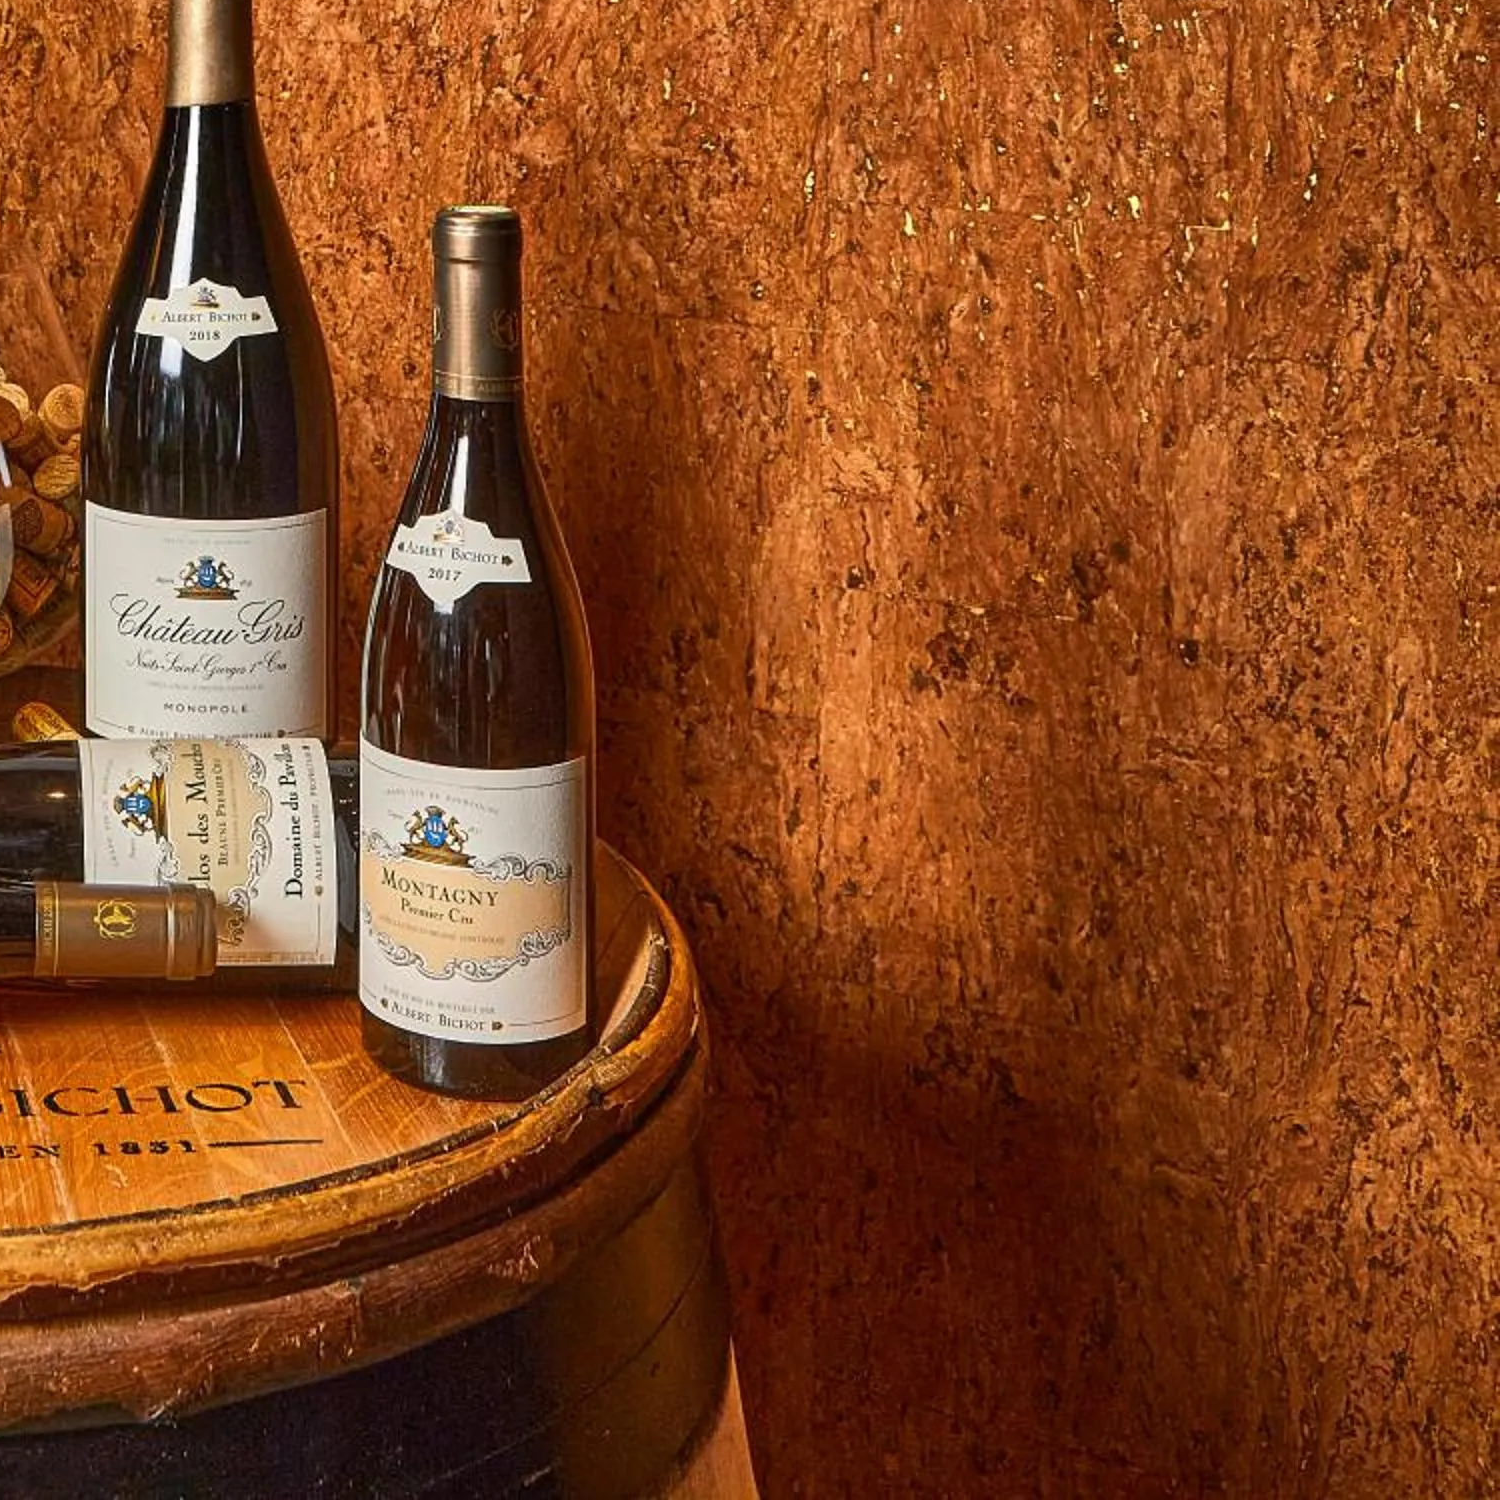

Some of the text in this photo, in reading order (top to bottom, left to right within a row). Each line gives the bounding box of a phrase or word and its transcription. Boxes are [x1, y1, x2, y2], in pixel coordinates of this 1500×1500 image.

[427, 567, 463, 582] 2017
[109, 593, 307, 646] Château Gris
[163, 701, 249, 715] MONOPOLE
[187, 813, 210, 845] des
[273, 742, 304, 901] Domaine du Pavillon
[216, 821, 230, 867] BEAUNE
[381, 865, 500, 908] MONTAGNY
[400, 897, 474, 925] Premier Cru
[391, 1000, 434, 1023] ALBERT
[438, 1013, 486, 1032] BICHOT
